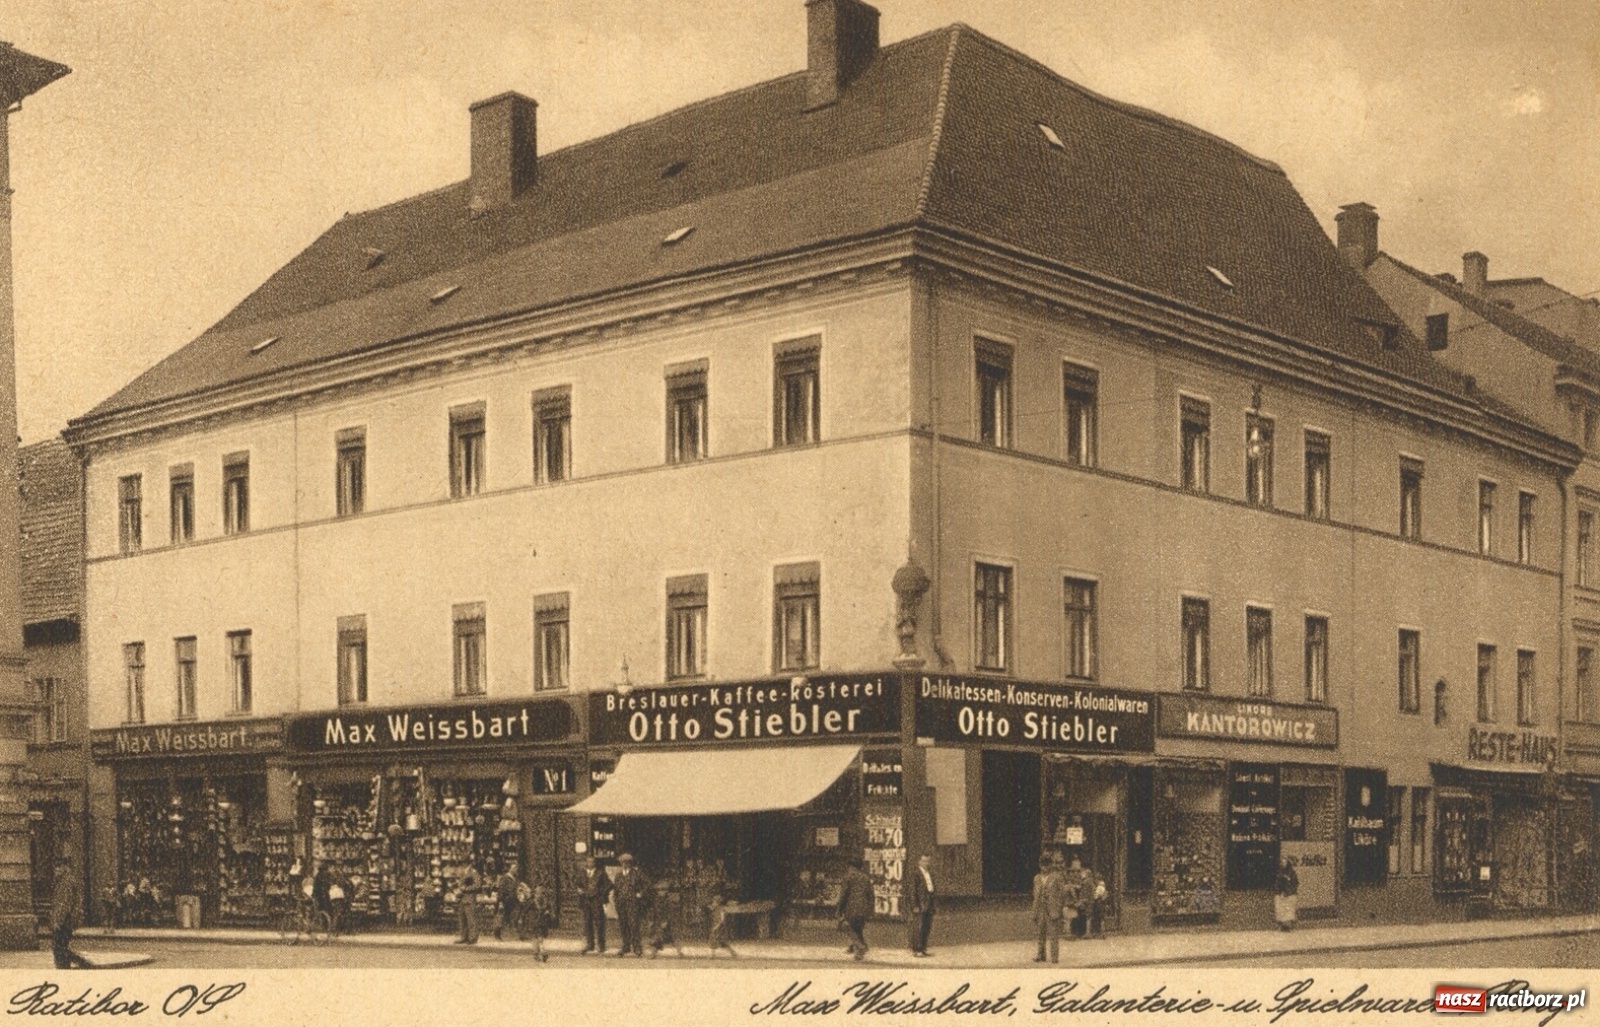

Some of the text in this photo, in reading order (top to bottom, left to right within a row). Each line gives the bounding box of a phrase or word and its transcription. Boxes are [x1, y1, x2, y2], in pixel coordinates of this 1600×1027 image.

[922, 677, 1148, 714] Delikatessen-Konserven-Kolonialwaren
[115, 725, 248, 753] Max Weissbart
[324, 709, 529, 746] Max Weissbart
[628, 703, 861, 742] Otto Stiebler
[957, 706, 1119, 744] Otto Stiebler
[1187, 711, 1316, 740] KANTOROWICZ
